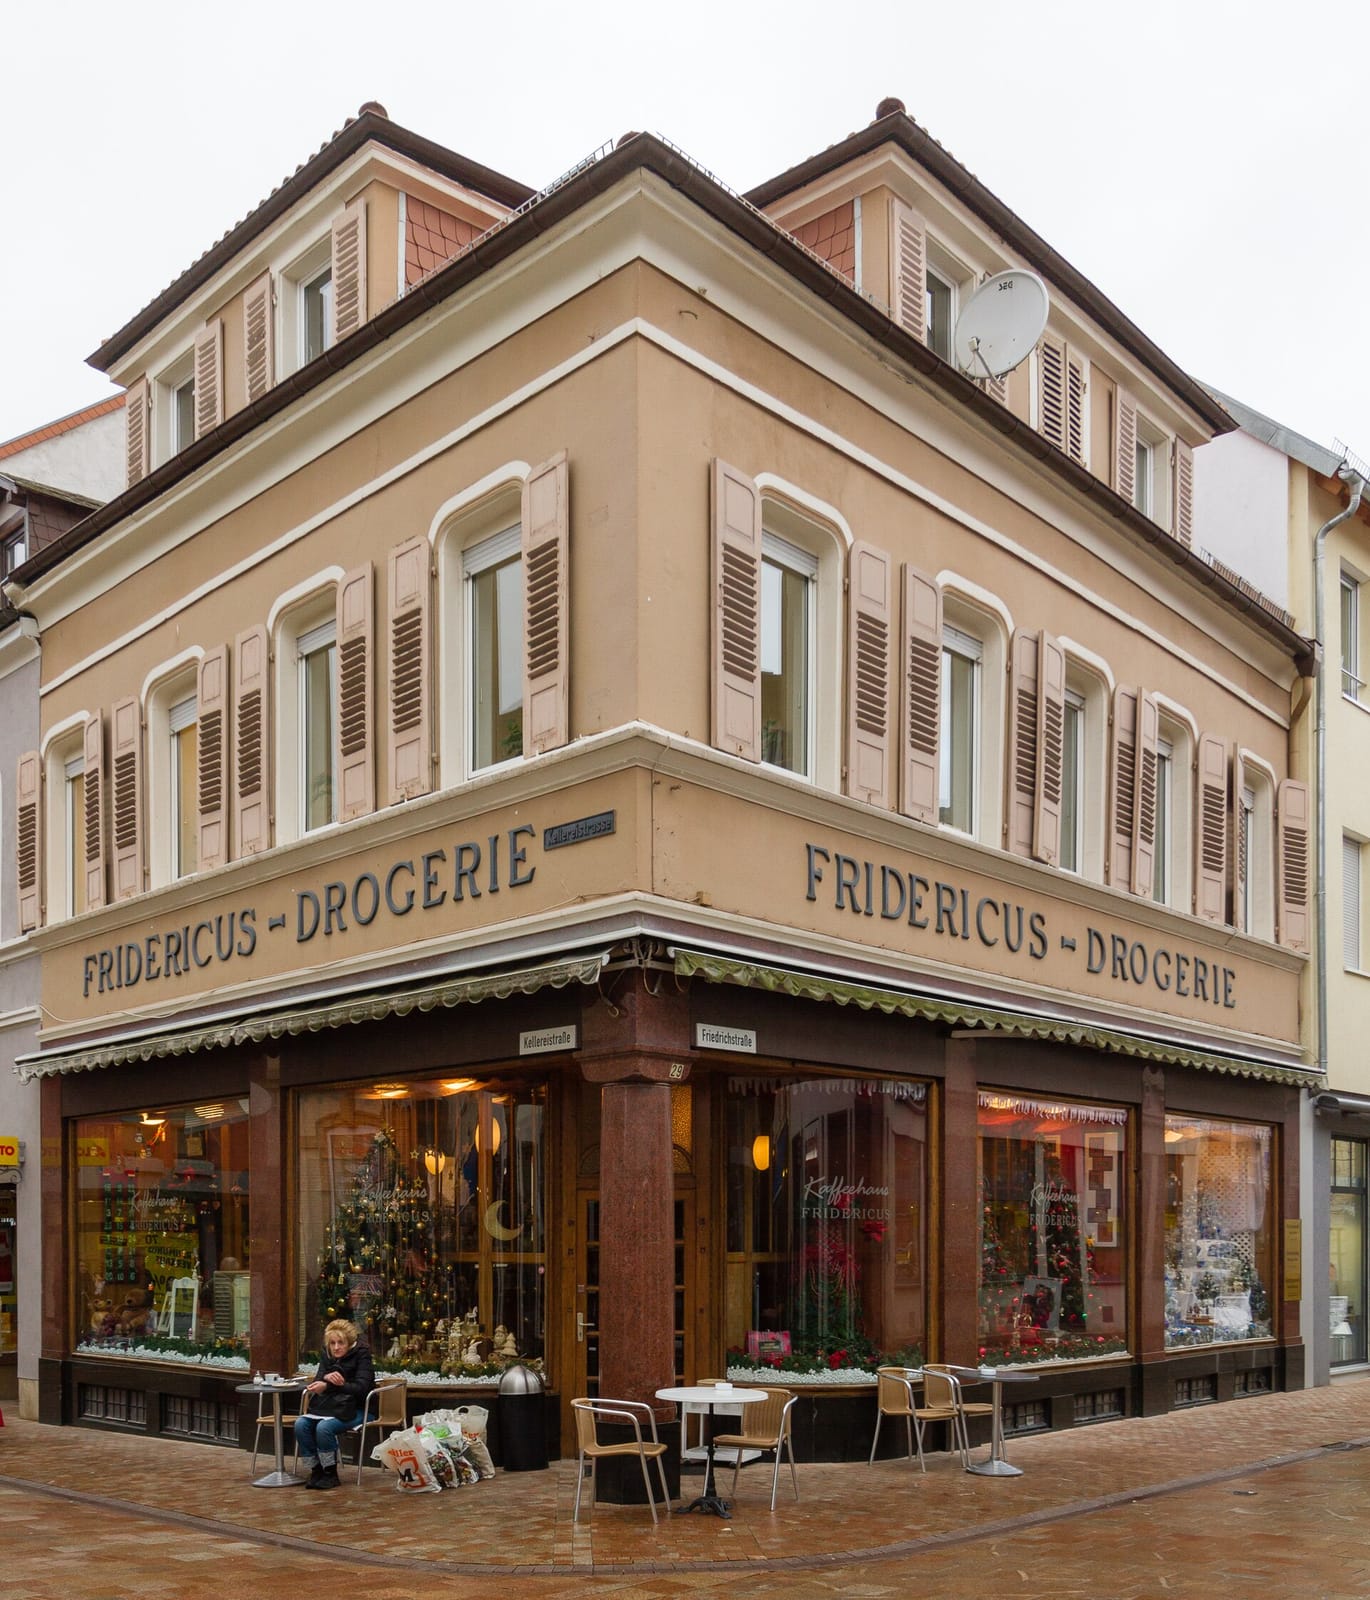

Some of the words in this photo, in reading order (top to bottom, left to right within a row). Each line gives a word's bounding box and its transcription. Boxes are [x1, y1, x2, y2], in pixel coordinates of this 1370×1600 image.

[547, 813, 613, 846] Kellereistrasse
[83, 908, 256, 997] FRIDERICUS
[296, 824, 536, 943] DROGERIE
[805, 843, 1049, 960] FRIDERICUS
[1087, 927, 1237, 1008] DROGERIE
[523, 1031, 572, 1050] Kellereistraße
[701, 1028, 753, 1048] Friedrichstraße
[670, 1064, 683, 1078] 29
[804, 1175, 889, 1206] Kaffeehaus
[801, 1207, 890, 1220] FRIDERICUS
[1029, 1213, 1082, 1228] FRIDERICUS
